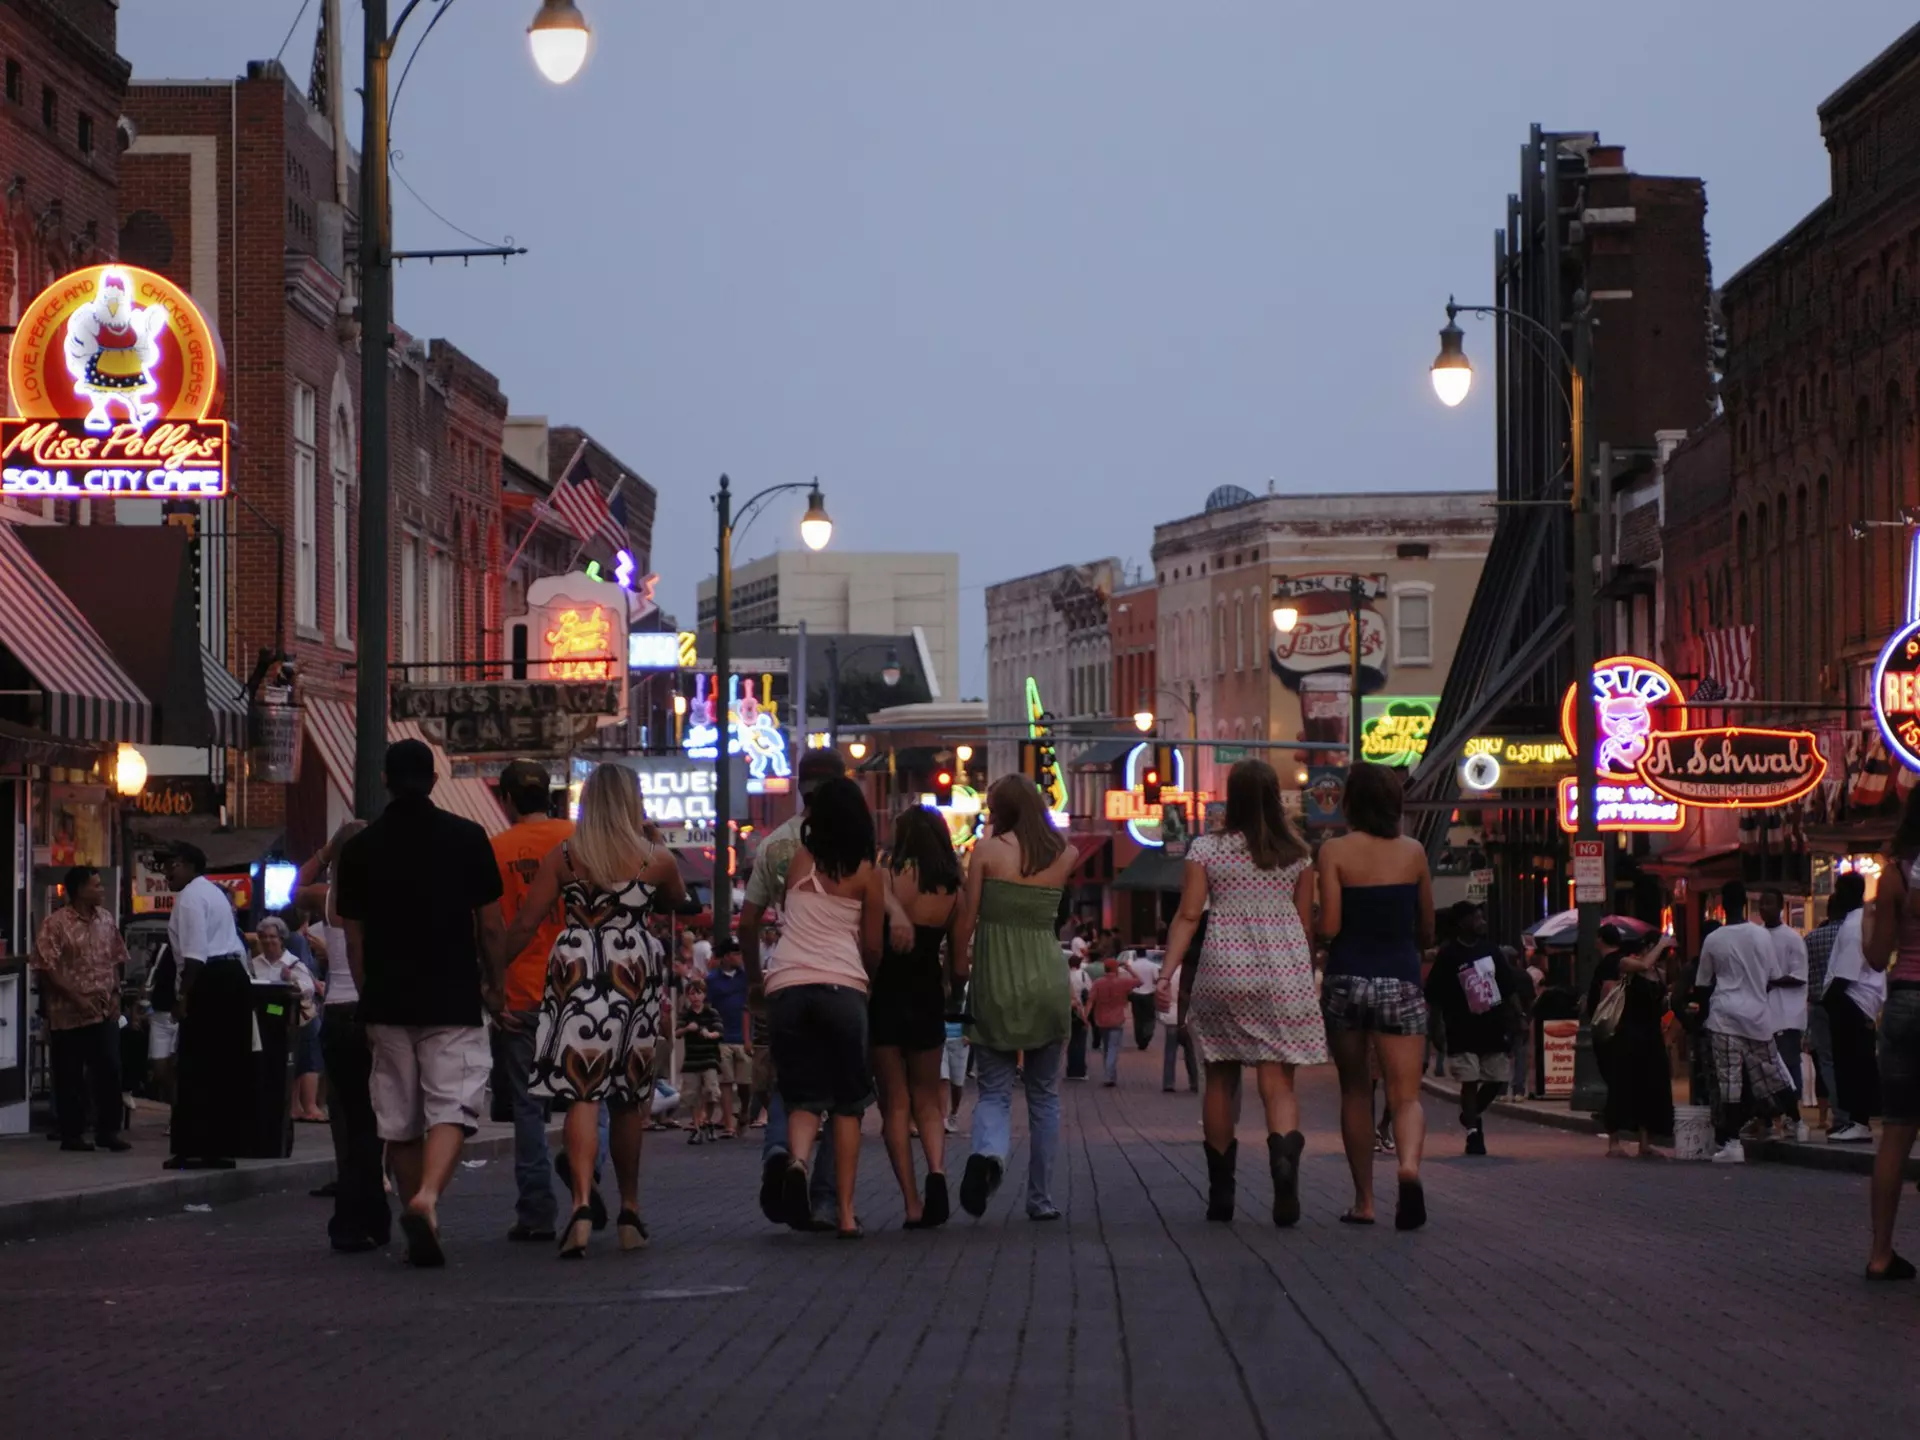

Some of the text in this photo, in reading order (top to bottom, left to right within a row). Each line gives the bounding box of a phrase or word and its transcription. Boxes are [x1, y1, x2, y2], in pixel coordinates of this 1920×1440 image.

[28, 299, 65, 349] PEACE
[64, 279, 95, 303] AND
[140, 282, 194, 337] CHICKEN
[184, 339, 206, 407] GREASE
[2, 422, 100, 459] Miss
[2, 468, 220, 491] SOUL CITY CAFE
[1294, 578, 1326, 593] ASK
[1593, 664, 1671, 703] PIG
[1646, 736, 1815, 775] A. Schwab
[686, 830, 717, 844] JOIN
[1579, 843, 1598, 856] NO
